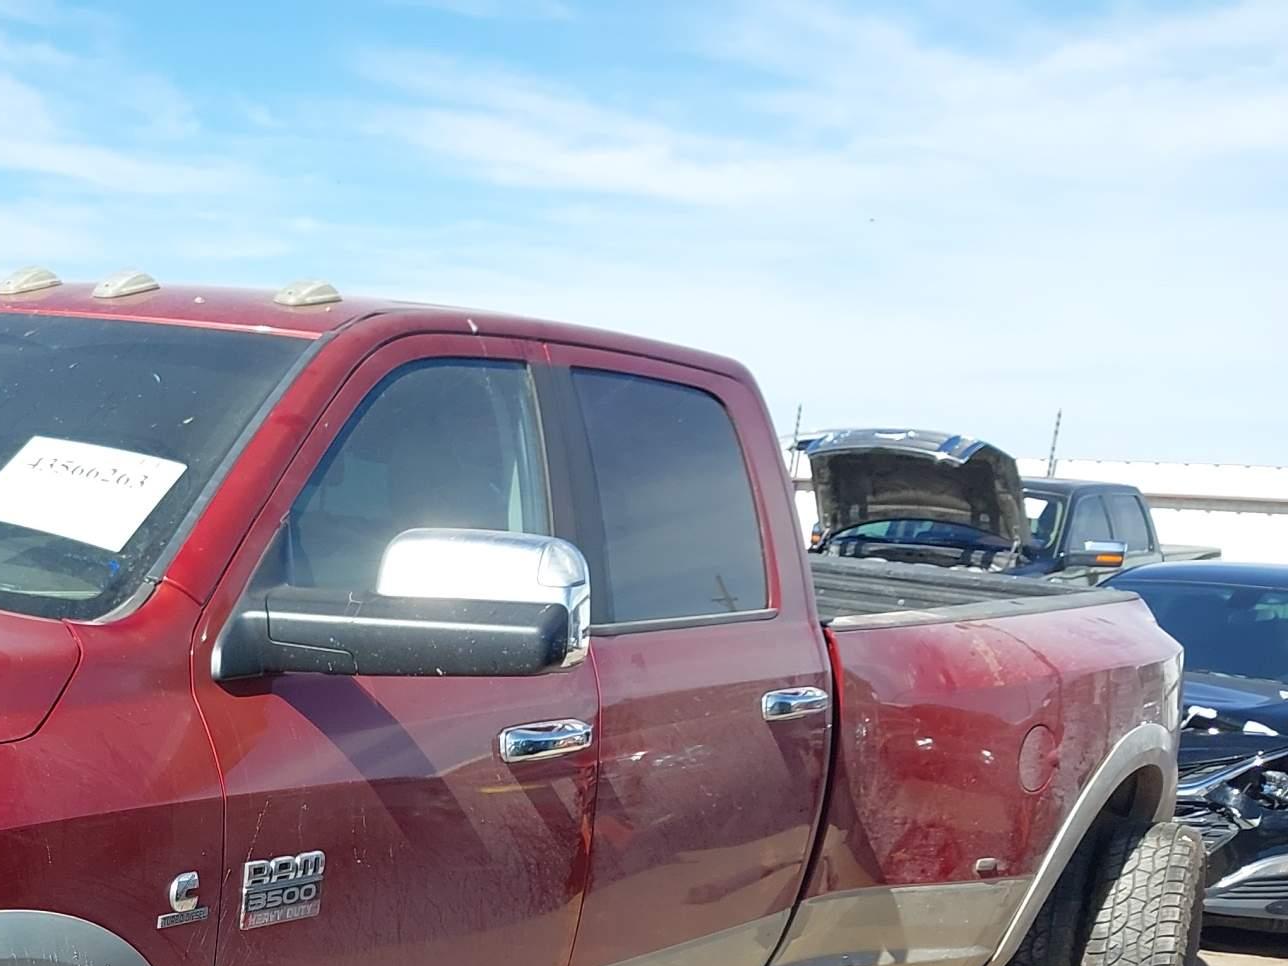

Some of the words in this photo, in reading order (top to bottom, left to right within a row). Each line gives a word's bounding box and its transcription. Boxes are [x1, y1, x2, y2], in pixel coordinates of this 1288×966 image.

[245, 850, 325, 887] RAM
[246, 884, 316, 913] 3500
[248, 907, 283, 926] HEAVY
[286, 903, 313, 918] DUTY
